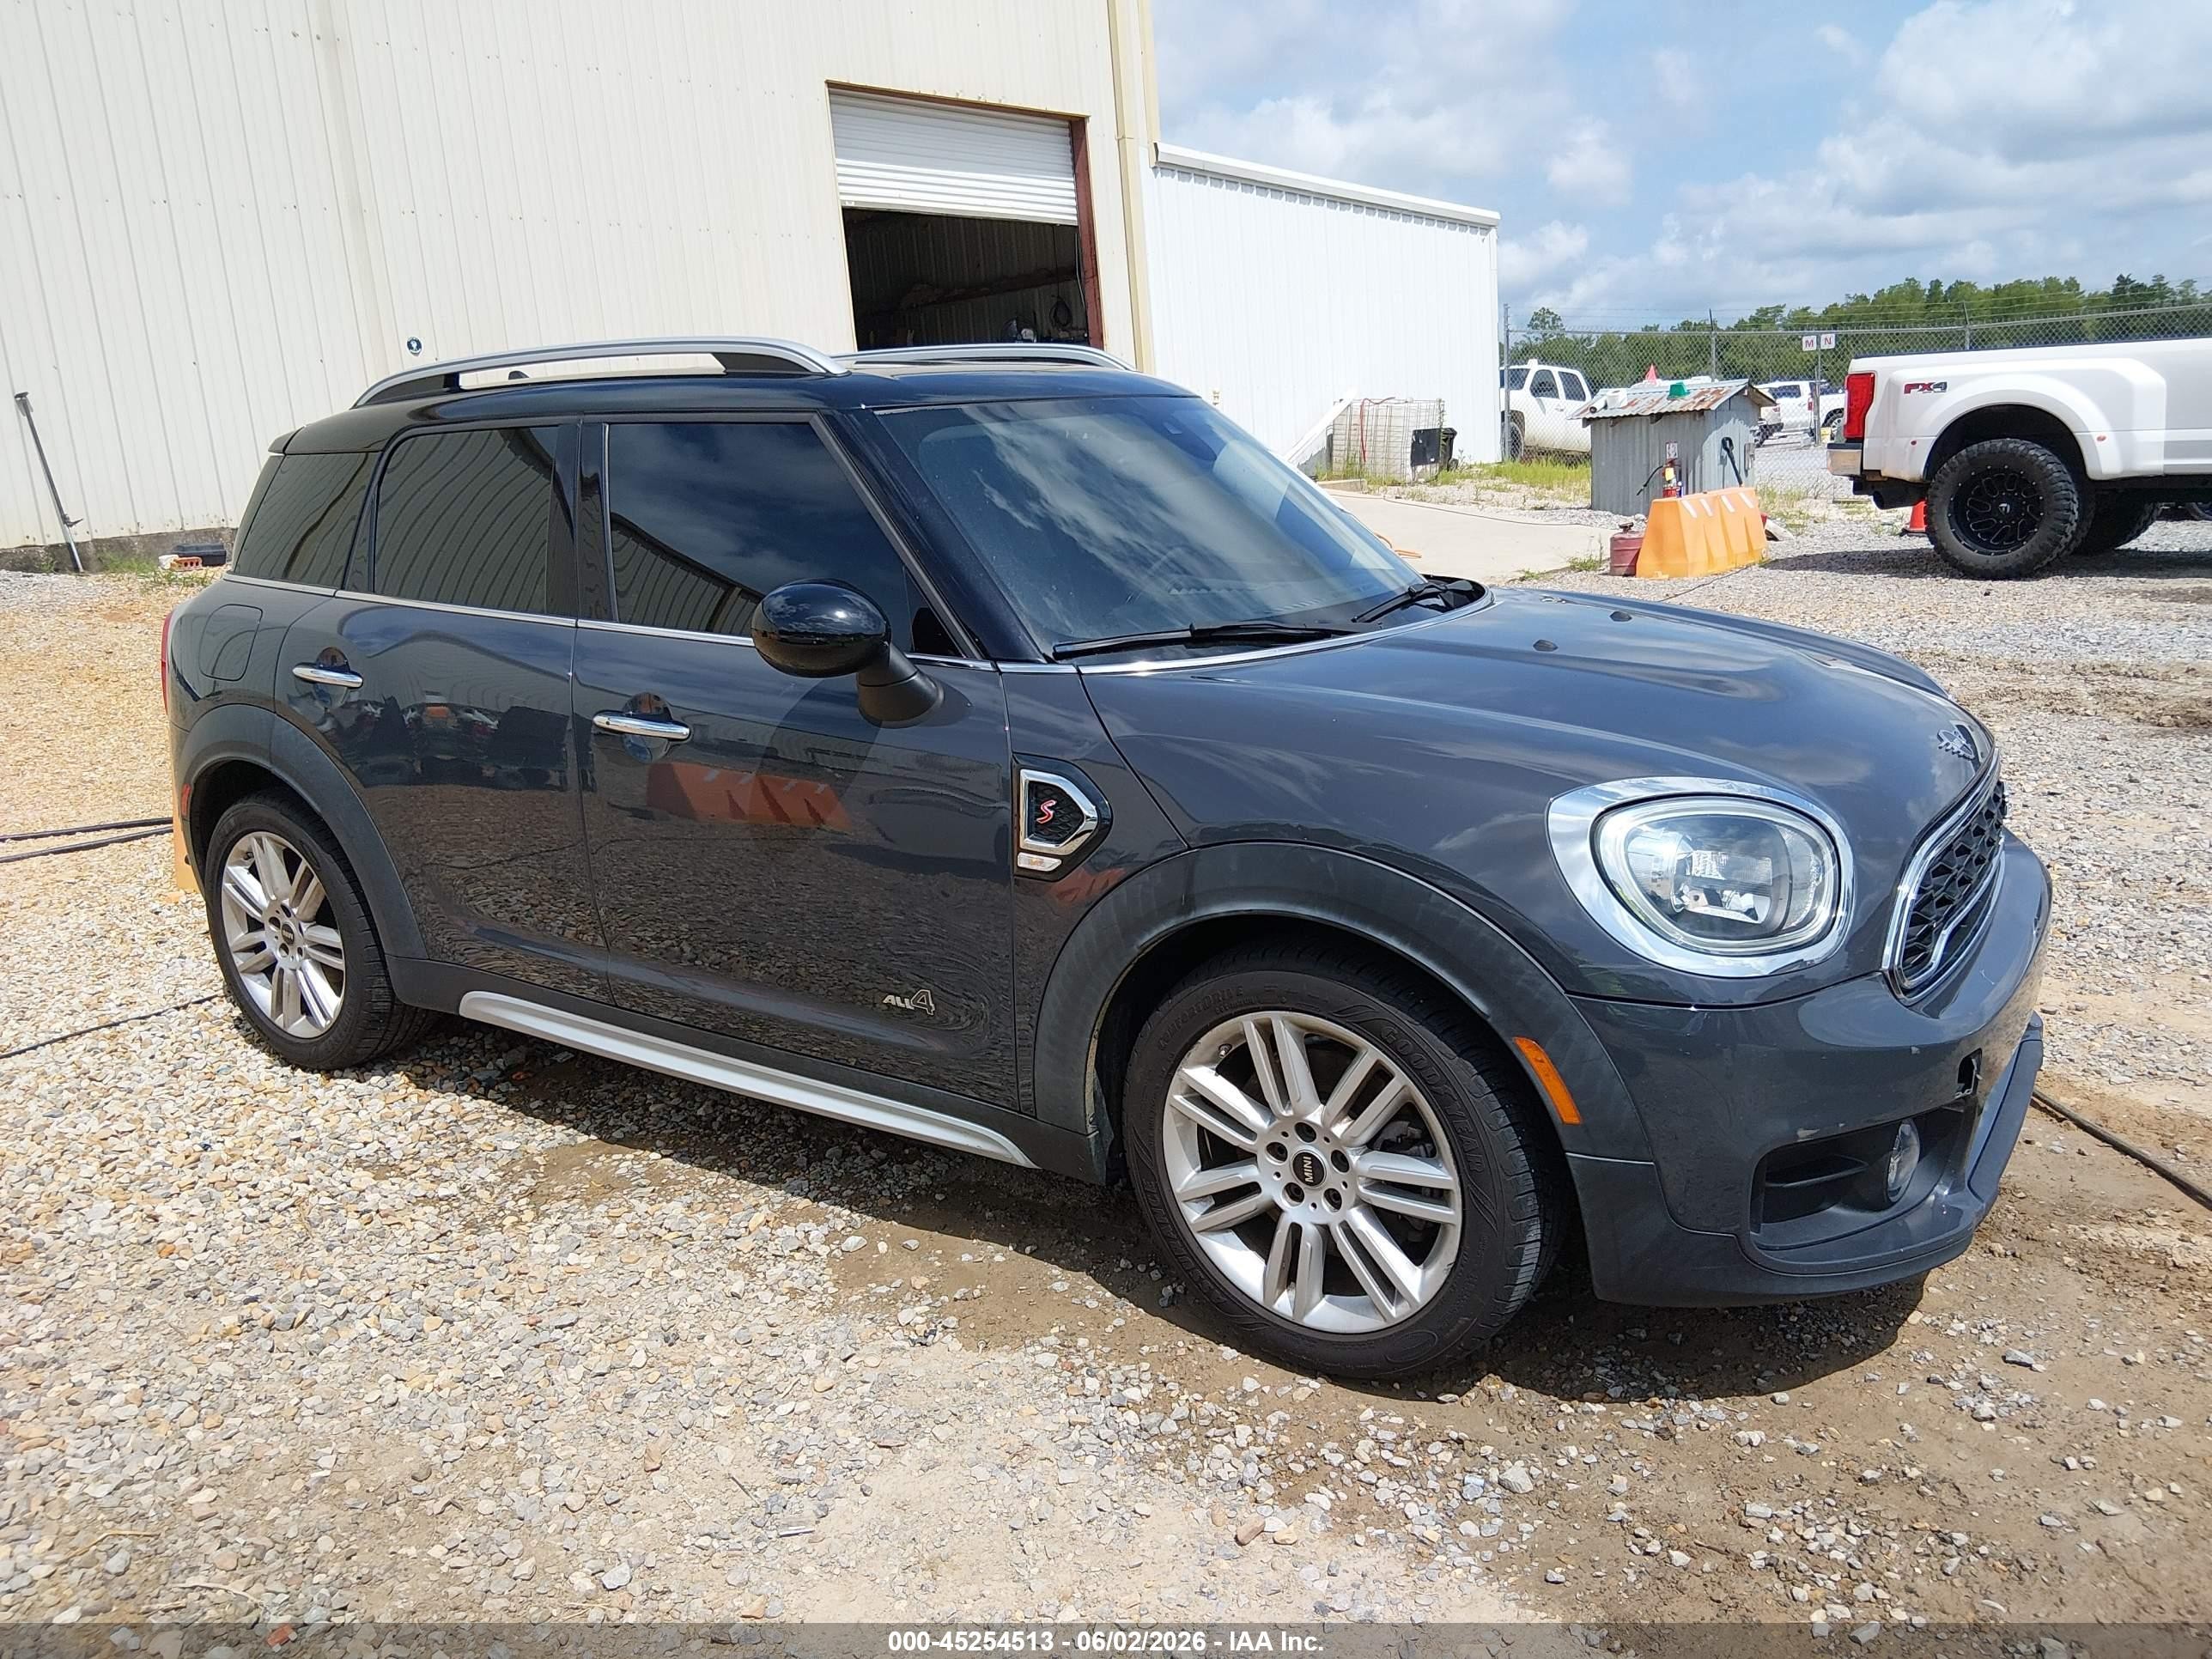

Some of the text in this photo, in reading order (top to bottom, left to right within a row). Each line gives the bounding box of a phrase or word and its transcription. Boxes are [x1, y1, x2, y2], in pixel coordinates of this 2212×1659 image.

[1805, 339, 1814, 348] M
[1824, 337, 1832, 345] N
[1904, 381, 1948, 394] FX4
[1036, 799, 1057, 824] S
[883, 989, 936, 1016] ALL4
[1380, 1025, 1486, 1173] GOODYEAR
[1303, 1156, 1314, 1182] MINI
